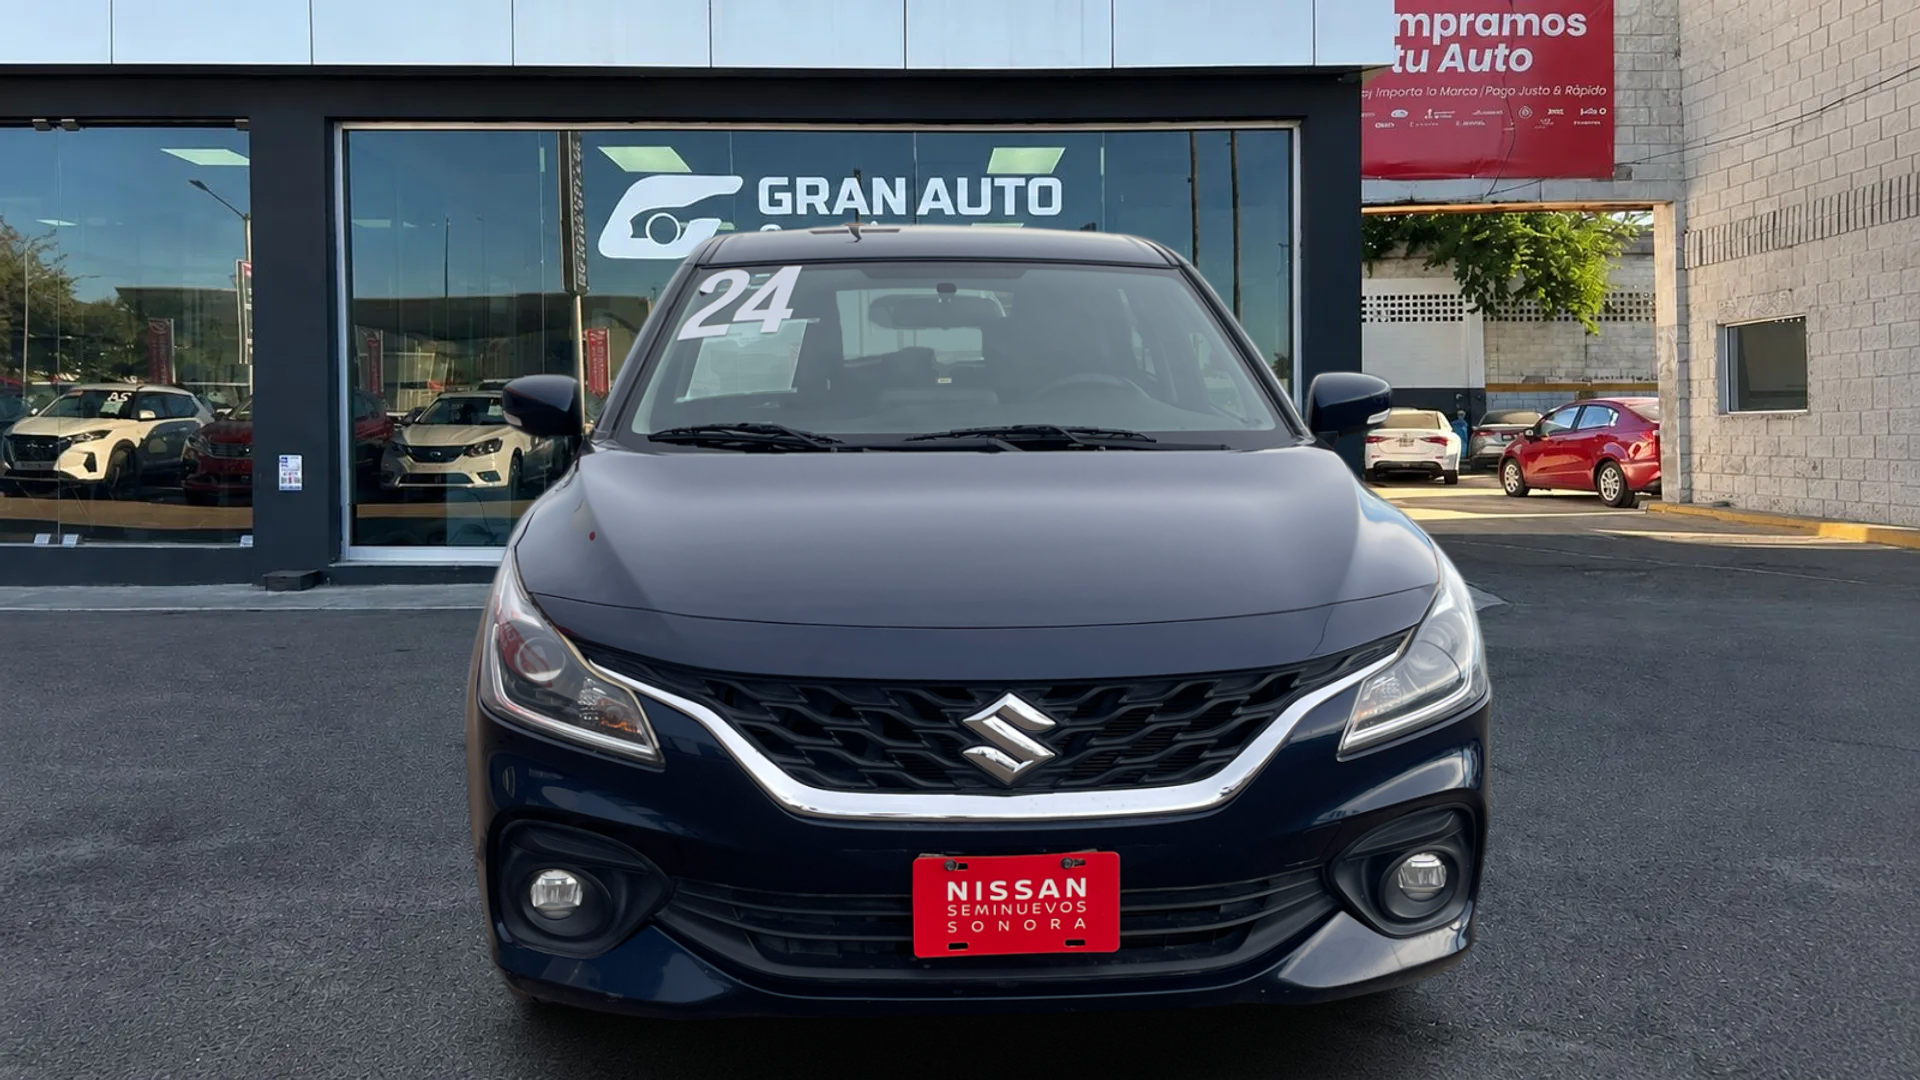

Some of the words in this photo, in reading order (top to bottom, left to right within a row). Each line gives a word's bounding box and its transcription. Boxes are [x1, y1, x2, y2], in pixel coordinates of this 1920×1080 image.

[1394, 13, 1587, 46] mpramos
[1392, 44, 1430, 73] tu
[1437, 43, 1533, 73] Auto
[1376, 87, 1423, 99] Importa
[1426, 86, 1437, 97] la
[1440, 86, 1478, 97] Marca
[1519, 86, 1550, 96] Justo
[1553, 85, 1562, 96] &
[1565, 84, 1607, 98] Rápido
[758, 176, 906, 216] GRAN
[915, 176, 1063, 216] AUTO
[677, 265, 803, 341] 24
[947, 877, 1087, 901] NISSAN
[947, 900, 1087, 917] SEMINUEVOS
[947, 917, 1087, 934] SONORA
